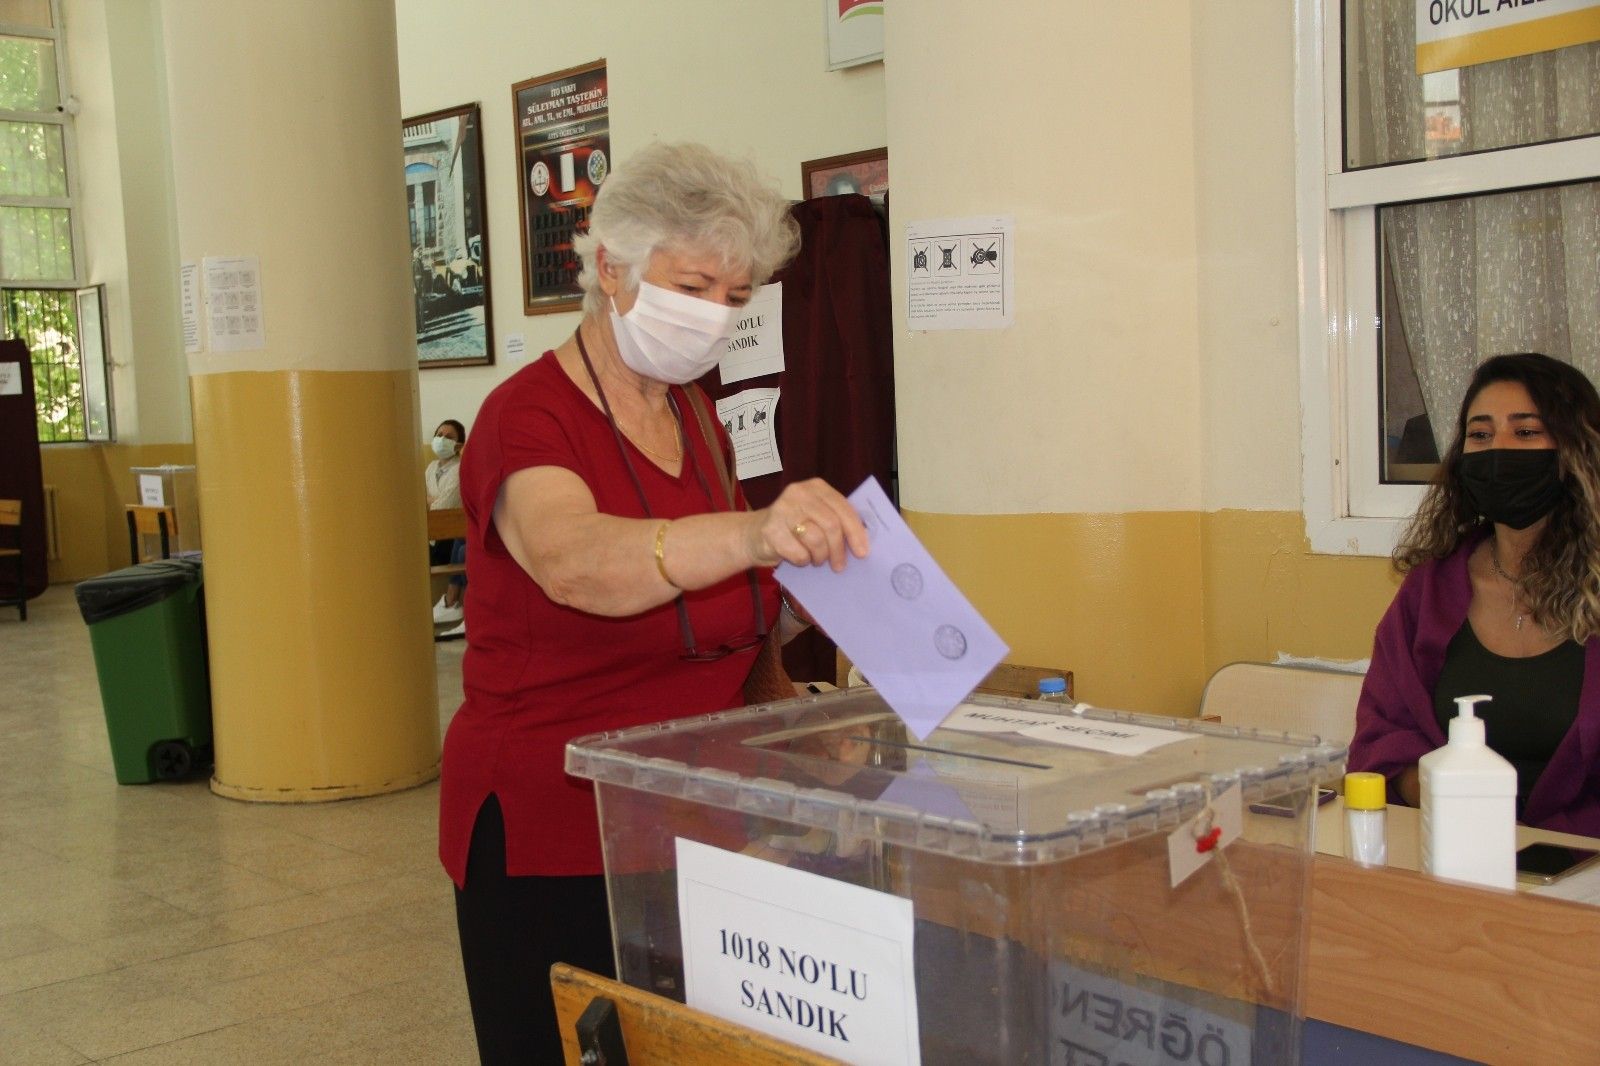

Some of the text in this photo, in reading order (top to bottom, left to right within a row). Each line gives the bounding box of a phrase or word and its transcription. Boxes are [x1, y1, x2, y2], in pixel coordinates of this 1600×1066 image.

[1429, 0, 1490, 25] OKUL
[527, 87, 603, 115] SÜLEYMAN TAŞTEKİN
[719, 928, 868, 1002] 1018 NO'LU
[740, 979, 850, 1044] SANDIK
